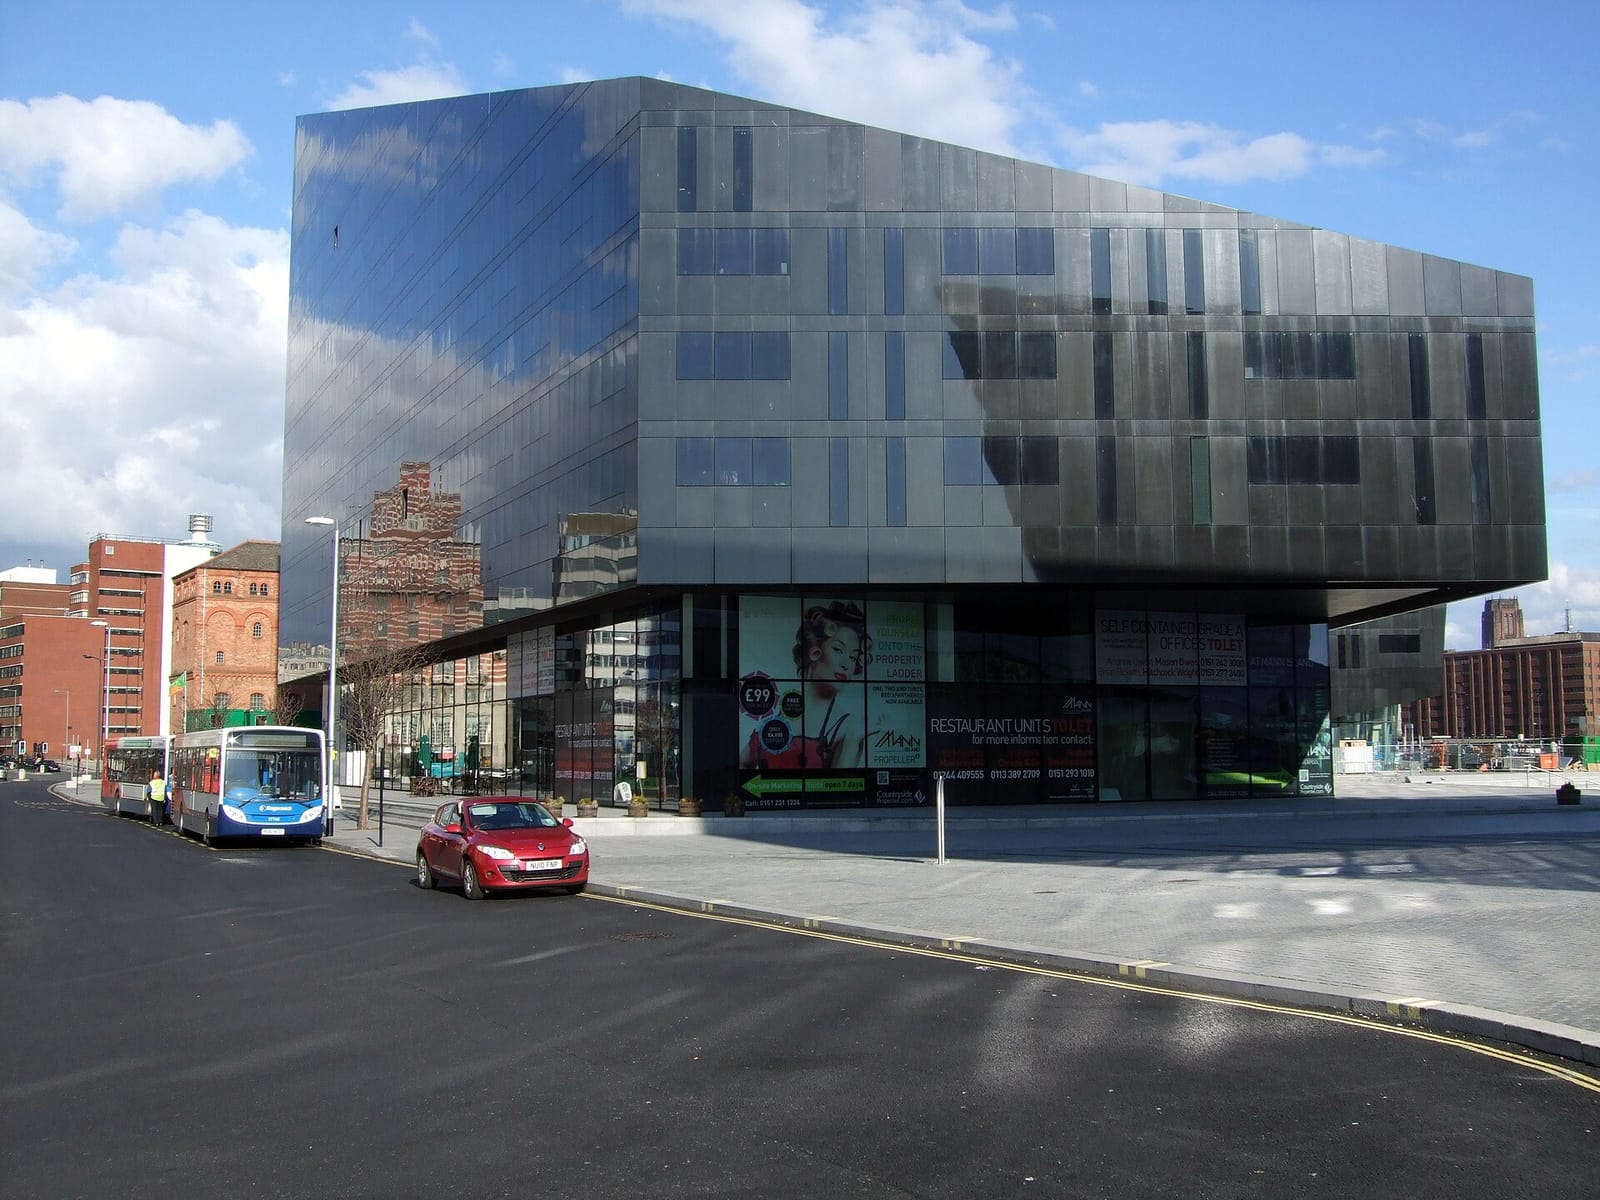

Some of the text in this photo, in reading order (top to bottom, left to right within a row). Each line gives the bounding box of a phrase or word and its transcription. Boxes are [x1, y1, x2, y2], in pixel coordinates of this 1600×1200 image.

[1101, 619, 1128, 633] SELF
[1200, 622, 1233, 636] GRADE
[1160, 636, 1244, 651] OFFICES TO LET
[876, 655, 922, 664] PROPERTY
[887, 669, 922, 678] LADDER
[745, 689, 770, 702] £99
[1062, 696, 1093, 709] MANN
[931, 718, 1012, 733] RESTAURANT
[1014, 718, 1051, 733] UNITS
[875, 730, 921, 747] MANN
[972, 734, 1094, 745] for more information contact:
[874, 755, 915, 764] PROPELLER
[956, 770, 985, 780] 409555
[990, 770, 1040, 779] 0113 389 2709
[1048, 769, 1095, 778] 0151 293 1010
[825, 780, 841, 789] open
[847, 779, 863, 789] days
[876, 790, 912, 799] Countryside
[745, 799, 759, 807] Call:
[760, 799, 775, 807] 0151
